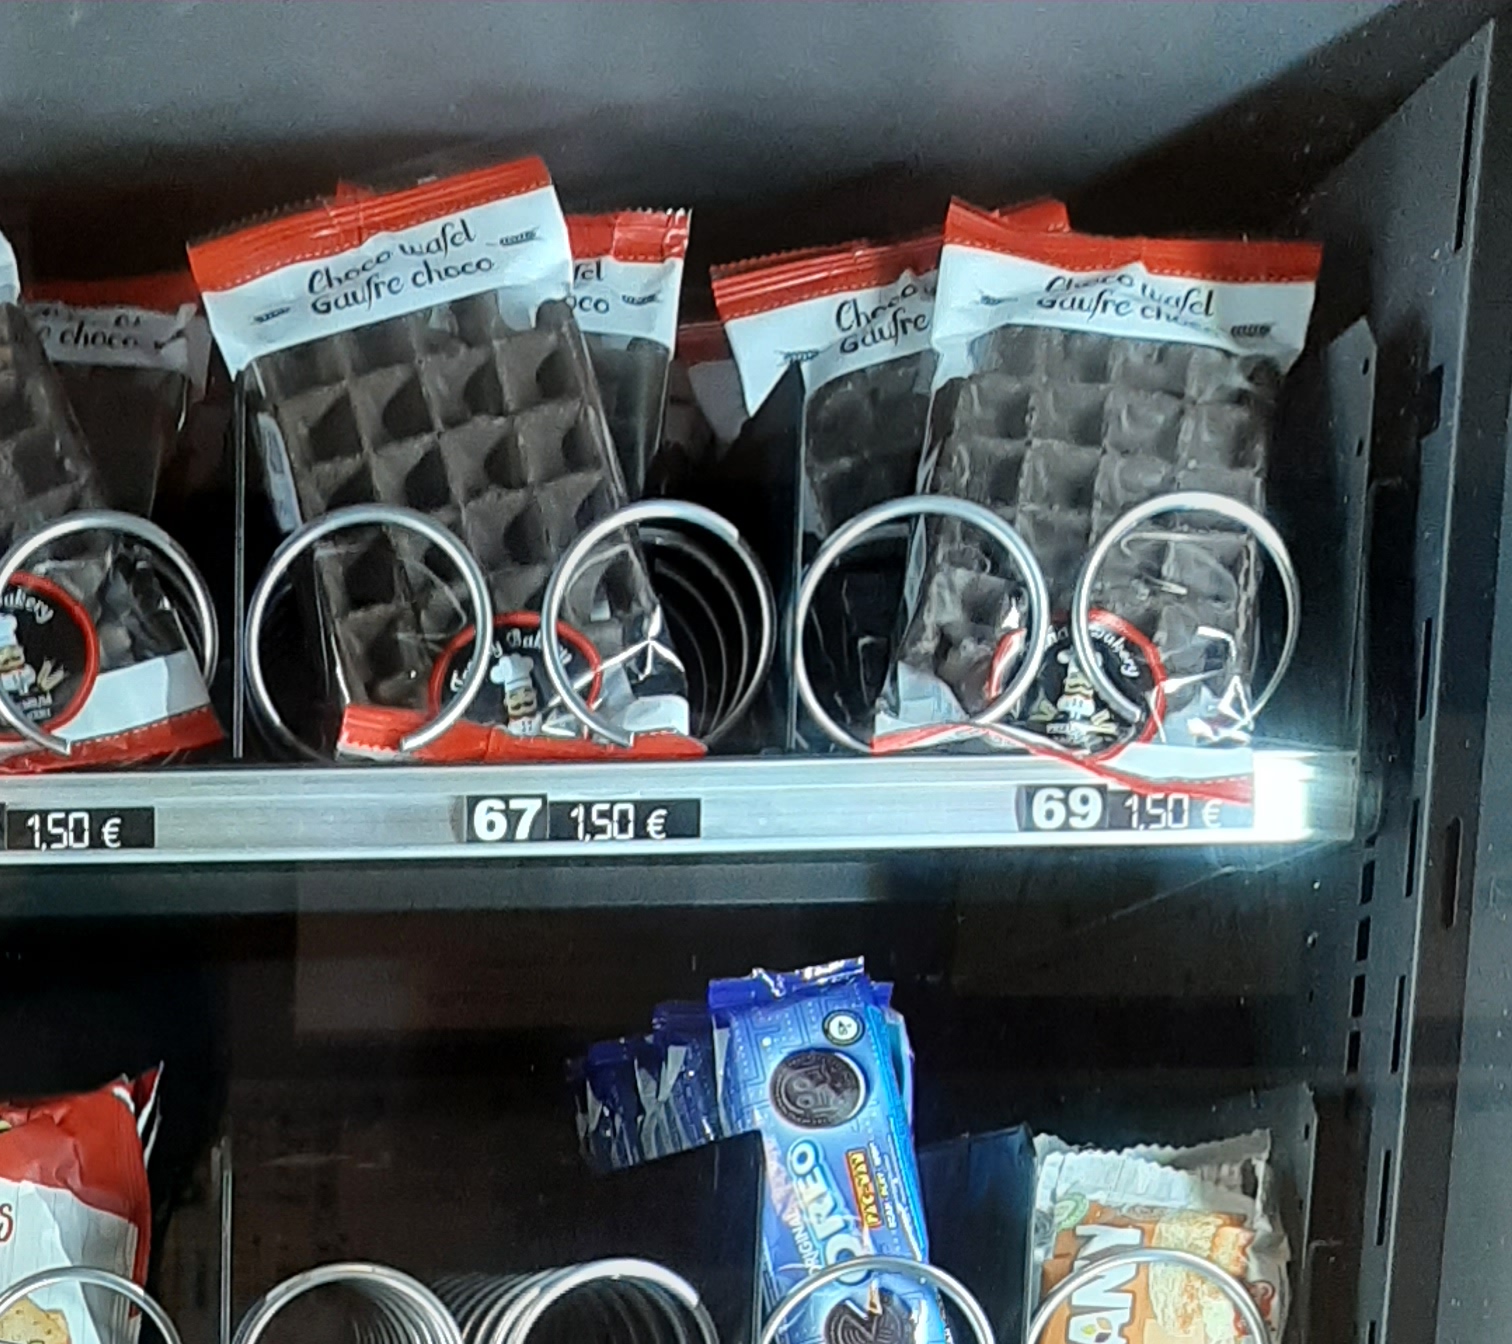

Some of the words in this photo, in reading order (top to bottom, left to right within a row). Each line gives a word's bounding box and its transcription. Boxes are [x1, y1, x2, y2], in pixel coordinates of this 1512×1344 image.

[308, 247, 392, 297] Choco
[311, 273, 404, 315] Gaufre
[411, 256, 494, 289] choco
[473, 798, 543, 842] 67
[570, 803, 634, 842] 1,50
[647, 808, 669, 841] €
[1032, 788, 1103, 829] 69
[27, 813, 91, 851] 1,50
[102, 819, 123, 848] €
[787, 1139, 872, 1288] OREO
